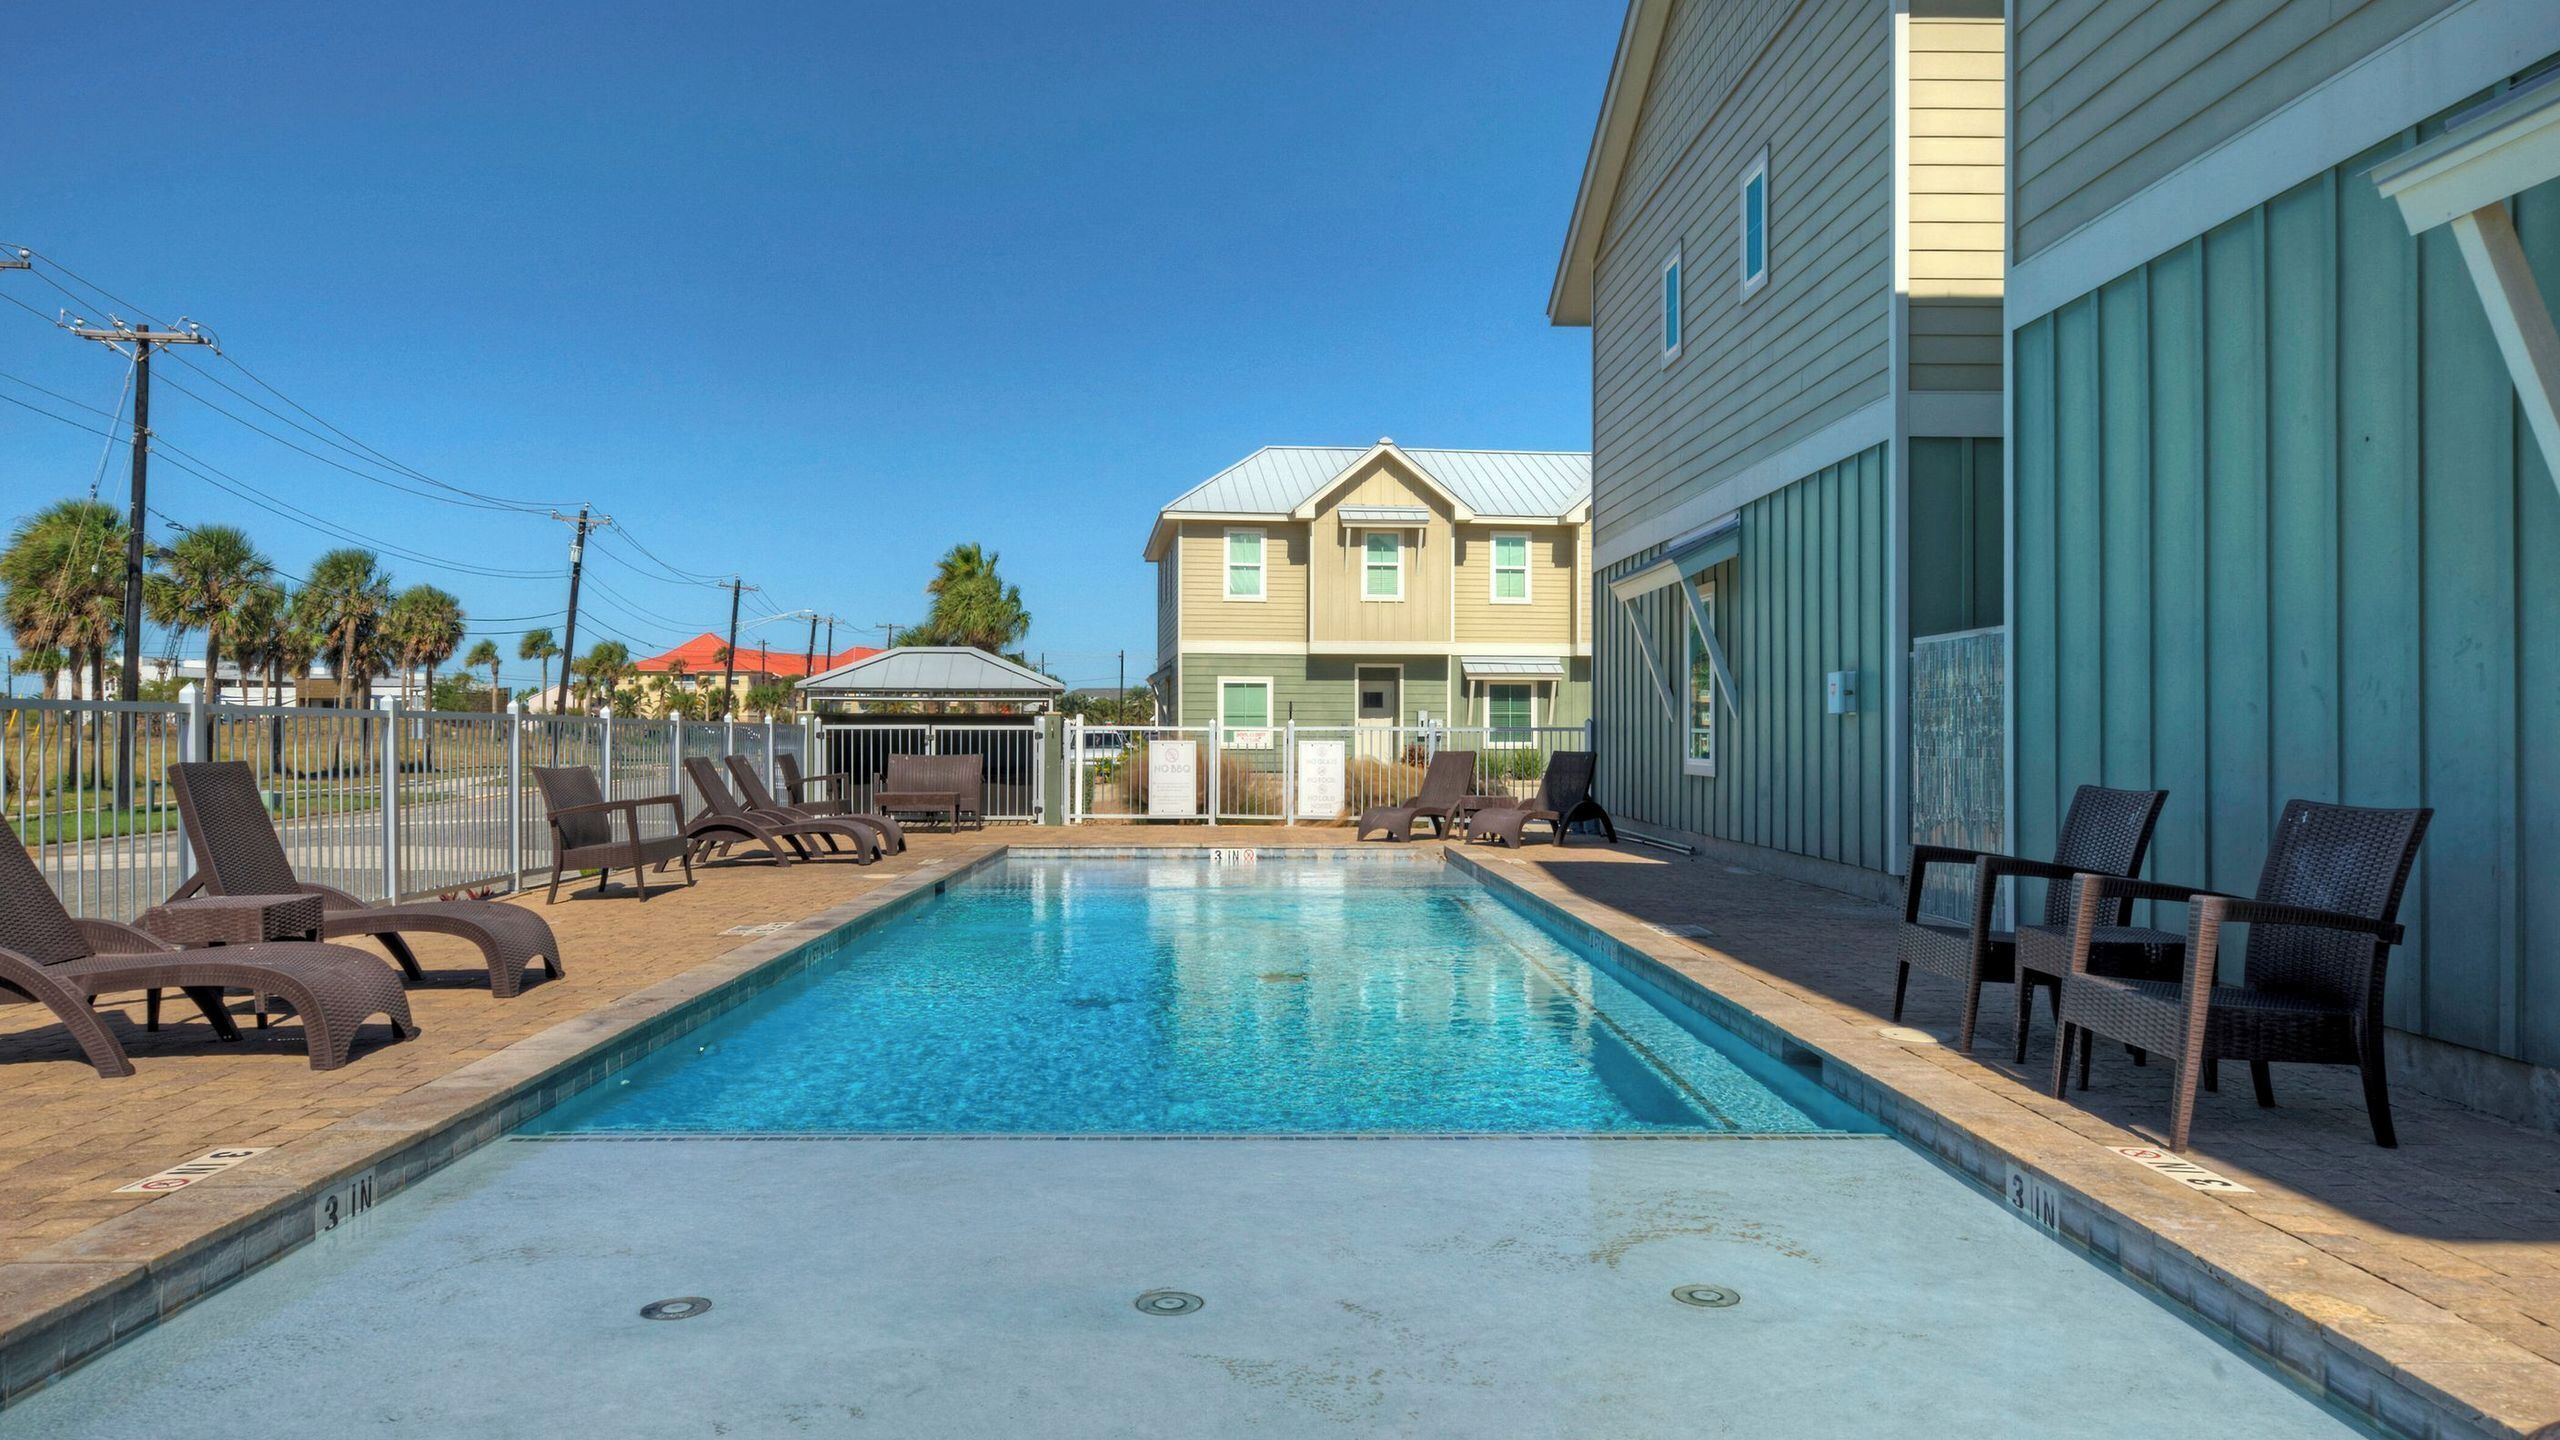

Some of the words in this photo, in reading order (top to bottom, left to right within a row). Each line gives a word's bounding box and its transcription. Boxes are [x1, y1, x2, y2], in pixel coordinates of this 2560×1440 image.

[1154, 764, 1169, 773] NO
[1170, 764, 1191, 773] BBQ
[1214, 850, 1222, 860] 3
[1228, 850, 1239, 860] IN
[209, 1151, 254, 1159] 3
[165, 1163, 229, 1175] IN
[2147, 1161, 2206, 1173] IN
[2186, 1178, 2232, 1187] 3
[324, 1195, 339, 1231] 3
[351, 1175, 373, 1217] IN
[2012, 1174, 2024, 1209] 3
[2035, 1185, 2055, 1230] IN
